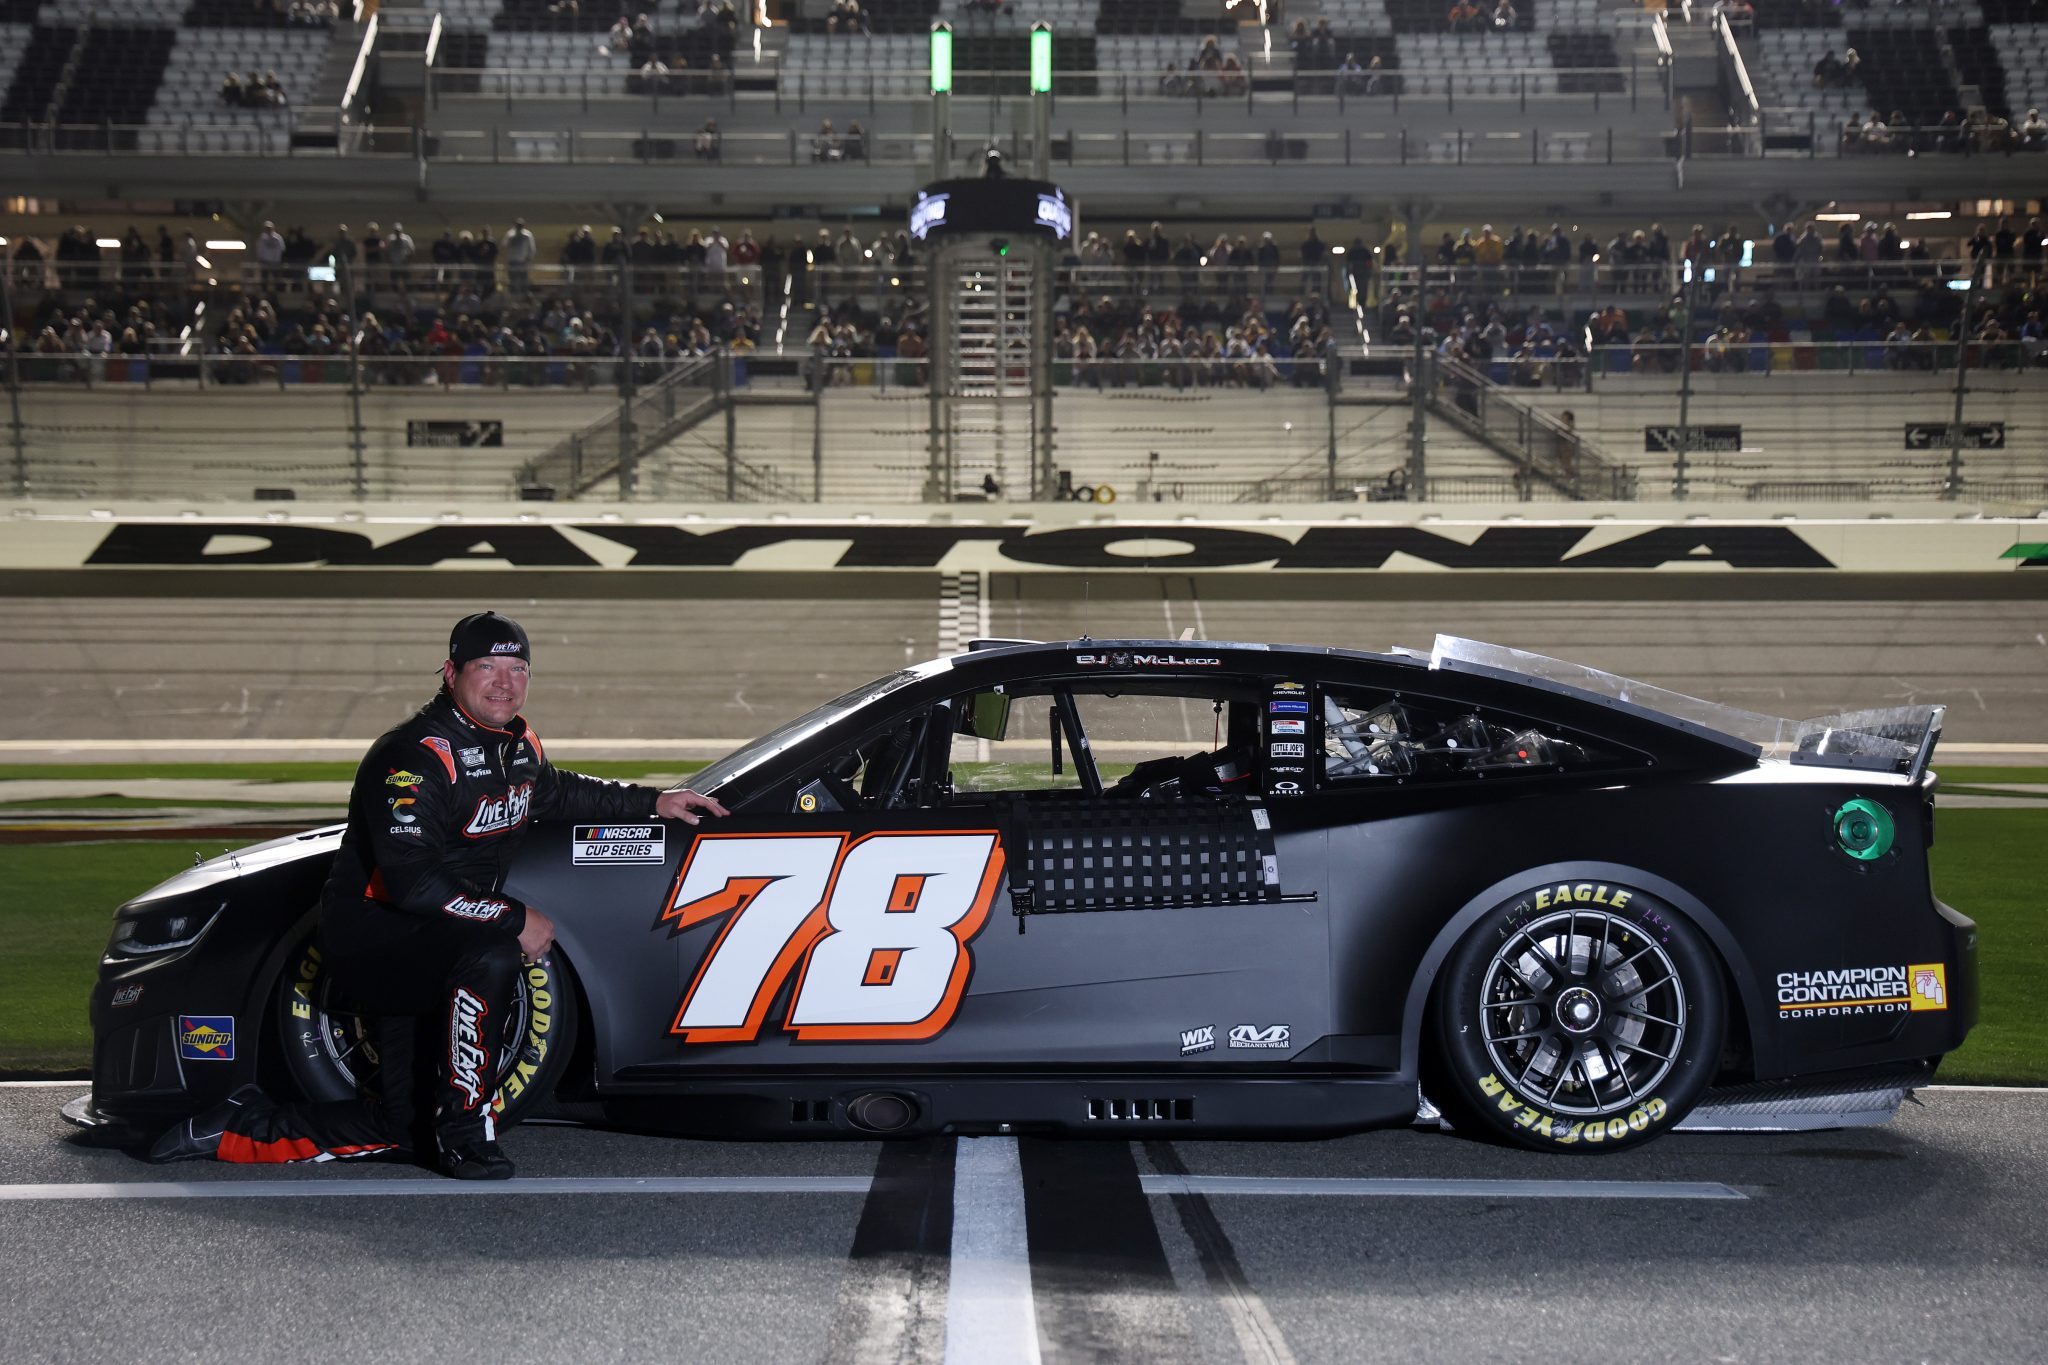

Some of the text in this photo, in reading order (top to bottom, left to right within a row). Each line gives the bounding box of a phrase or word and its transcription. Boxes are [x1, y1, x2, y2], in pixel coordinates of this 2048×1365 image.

[83, 523, 1838, 568] DAYTONA
[1076, 654, 1107, 664] BJ
[386, 775, 423, 784] SUNOCO
[390, 826, 421, 834] CELSIUS
[602, 828, 652, 839] NASCAR
[586, 844, 652, 856] CUP SERIES
[445, 896, 478, 912] LIVE
[1535, 883, 1633, 910] EAGLE
[661, 830, 1006, 1043] 78
[1777, 966, 1906, 988] CHAMPION
[1778, 982, 1908, 1003] CONTAINER
[1780, 1003, 1908, 1019] CORPORATION
[183, 1033, 231, 1044] SUNOCO
[1181, 1026, 1215, 1046] WIX
[1229, 1040, 1289, 1048] MECHANIX WEAR
[454, 988, 485, 1106] LIVE FAST
[1478, 1072, 1667, 1144] GOODYEAR
